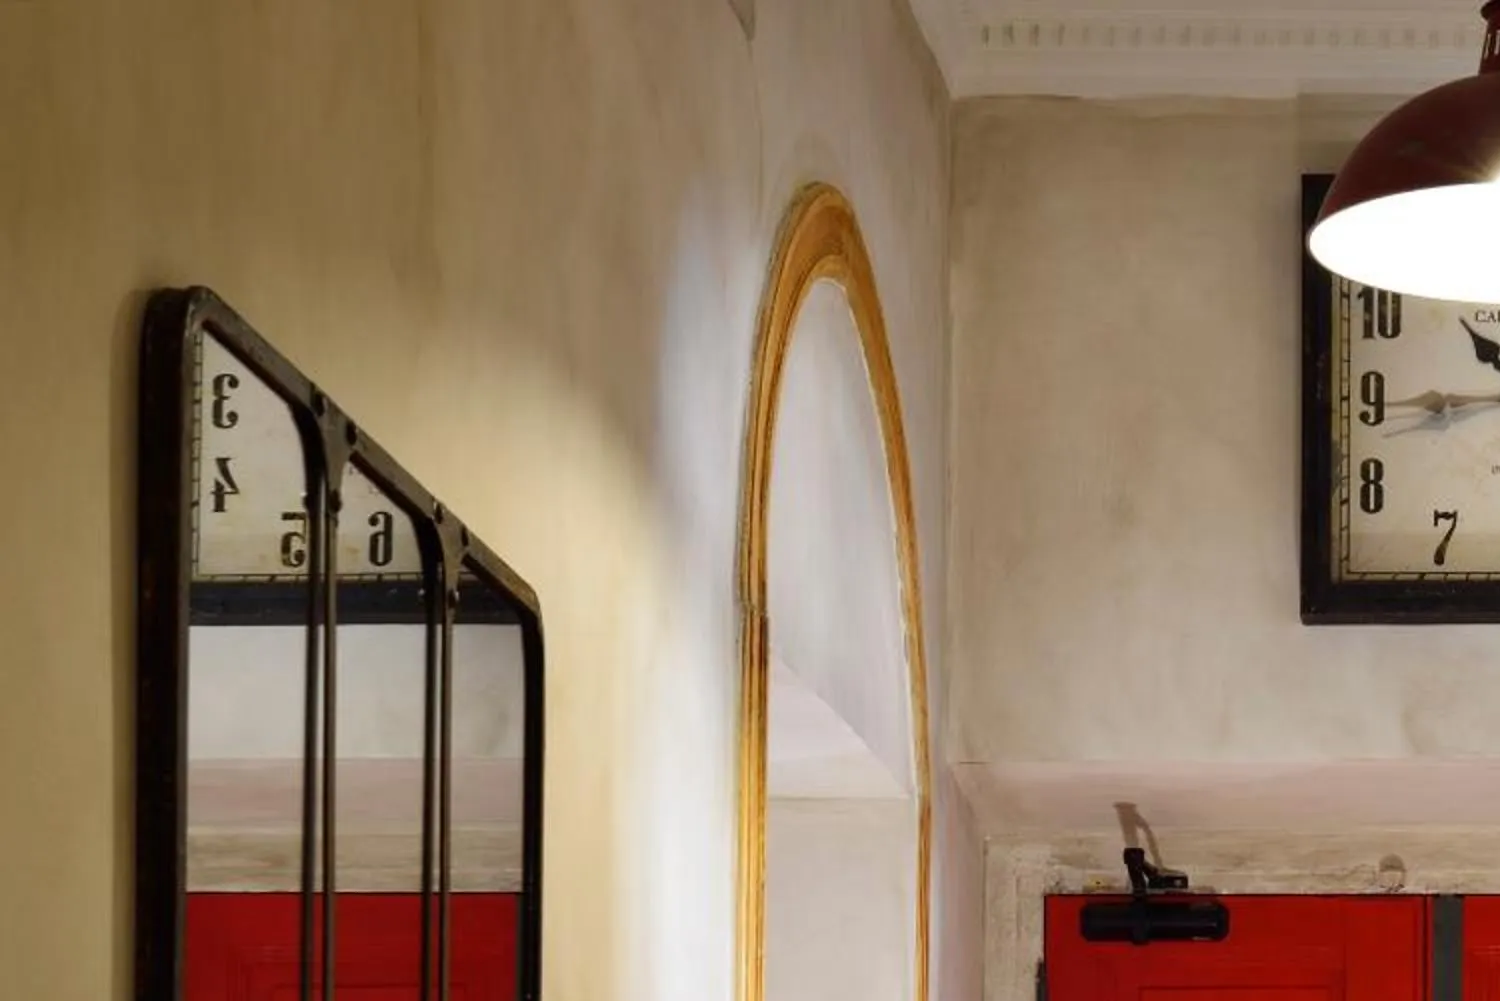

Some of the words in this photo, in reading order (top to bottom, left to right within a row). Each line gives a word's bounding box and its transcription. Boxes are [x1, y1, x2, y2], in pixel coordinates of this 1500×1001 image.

[1357, 286, 1402, 339] 10
[1359, 371, 1386, 426] 9
[1359, 458, 1384, 514] 8
[1433, 509, 1458, 566] 7
